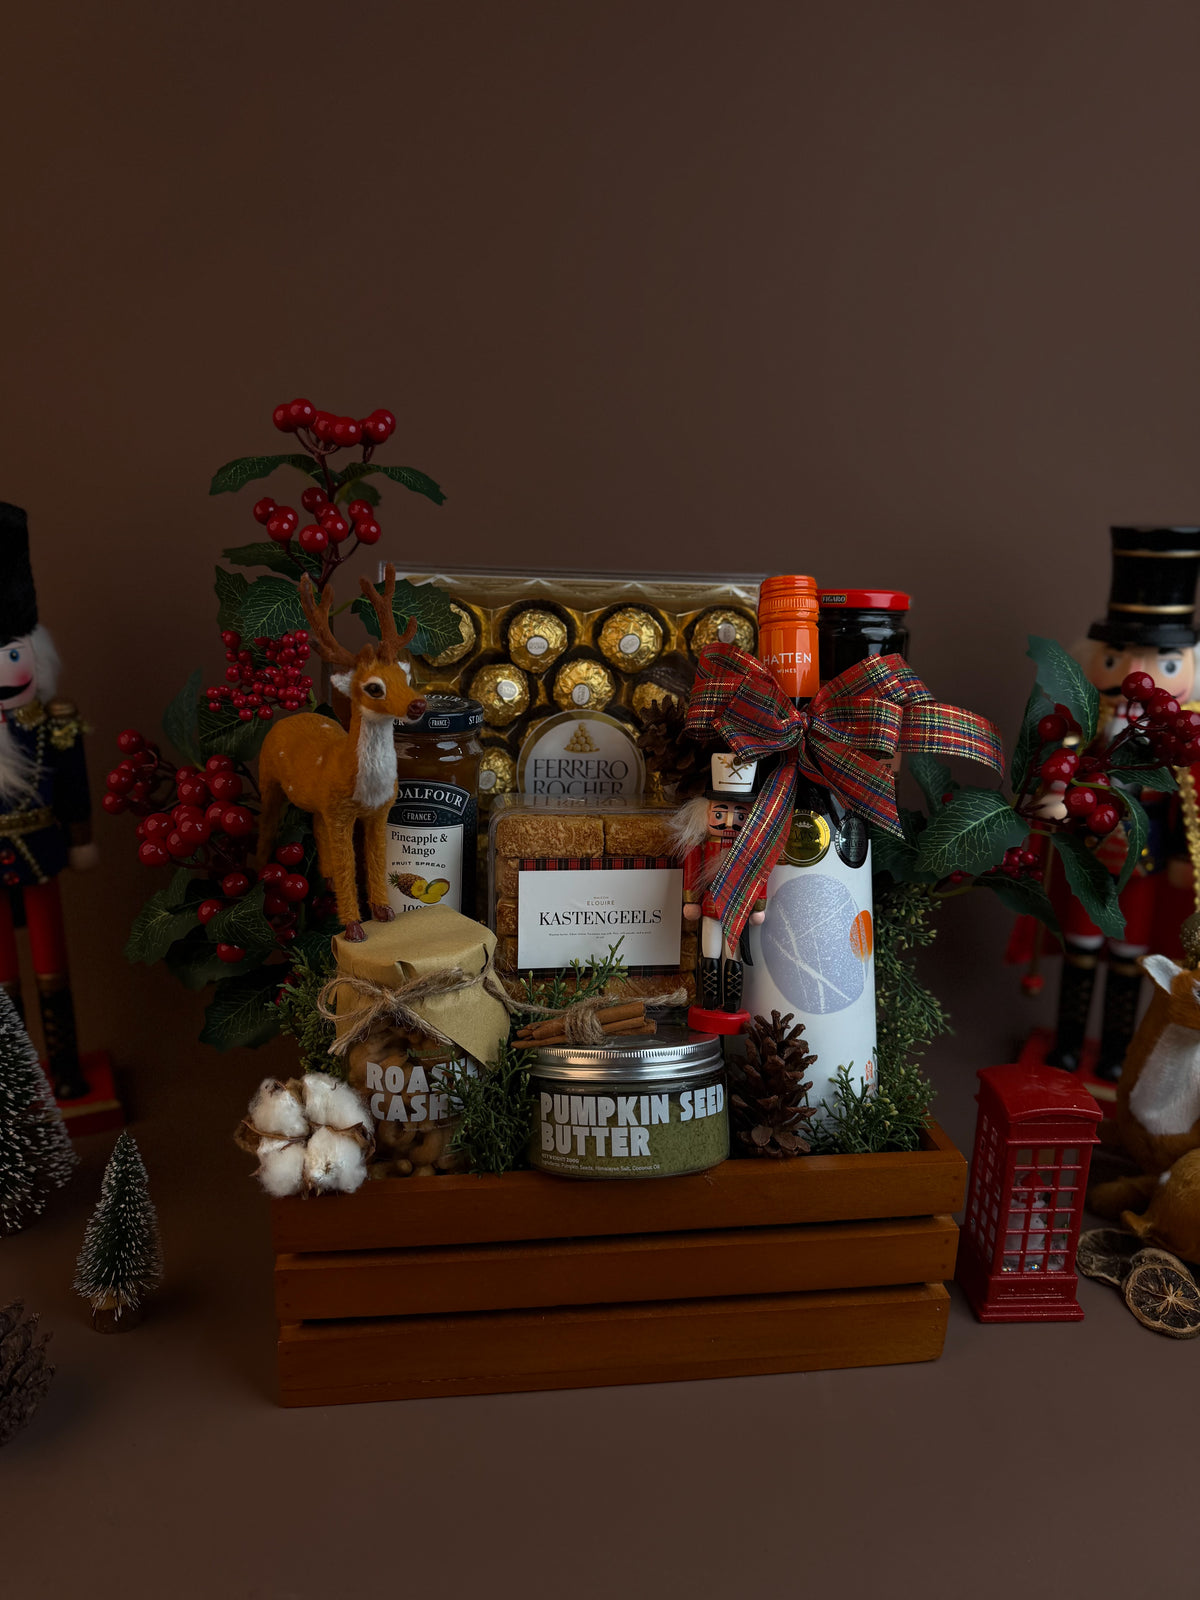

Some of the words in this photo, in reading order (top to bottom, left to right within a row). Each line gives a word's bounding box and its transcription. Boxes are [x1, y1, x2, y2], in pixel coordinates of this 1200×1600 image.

[822, 595, 846, 604] FIGARO
[763, 652, 812, 666] HATTEN
[431, 719, 448, 727] FRANCE
[533, 758, 629, 780] FERRERO
[533, 780, 623, 794] ROCHER
[407, 811, 432, 821] FRANCE
[391, 830, 437, 846] Pineapple
[440, 833, 448, 842] &
[402, 844, 436, 858] Mango
[415, 861, 446, 869] SPREAD
[539, 909, 662, 926] KASTENGEELS
[540, 1091, 670, 1127] PUMPKIN
[680, 1083, 724, 1122] SEED
[541, 1121, 651, 1157] BUTTER
